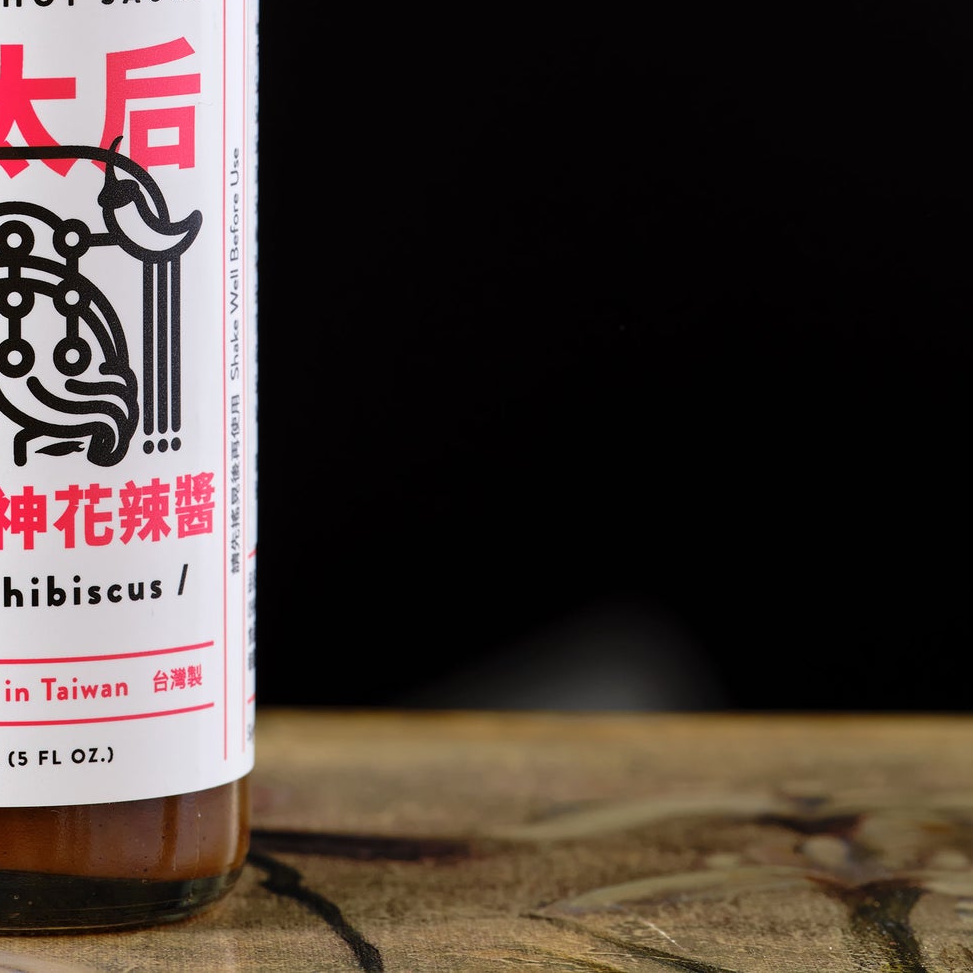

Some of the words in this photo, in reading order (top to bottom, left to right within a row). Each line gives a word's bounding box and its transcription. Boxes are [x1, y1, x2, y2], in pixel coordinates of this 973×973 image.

[230, 147, 239, 186] Use
[230, 193, 239, 261] Before
[230, 269, 239, 315] Well
[230, 320, 239, 380] Shake
[3, 574, 163, 608] hibiscus
[5, 679, 30, 702] in
[40, 676, 129, 701] Taiwan
[152, 664, 203, 694] 台灣製
[7, 750, 29, 768] (5
[38, 749, 62, 765] FL
[70, 746, 114, 765] OZ.)
